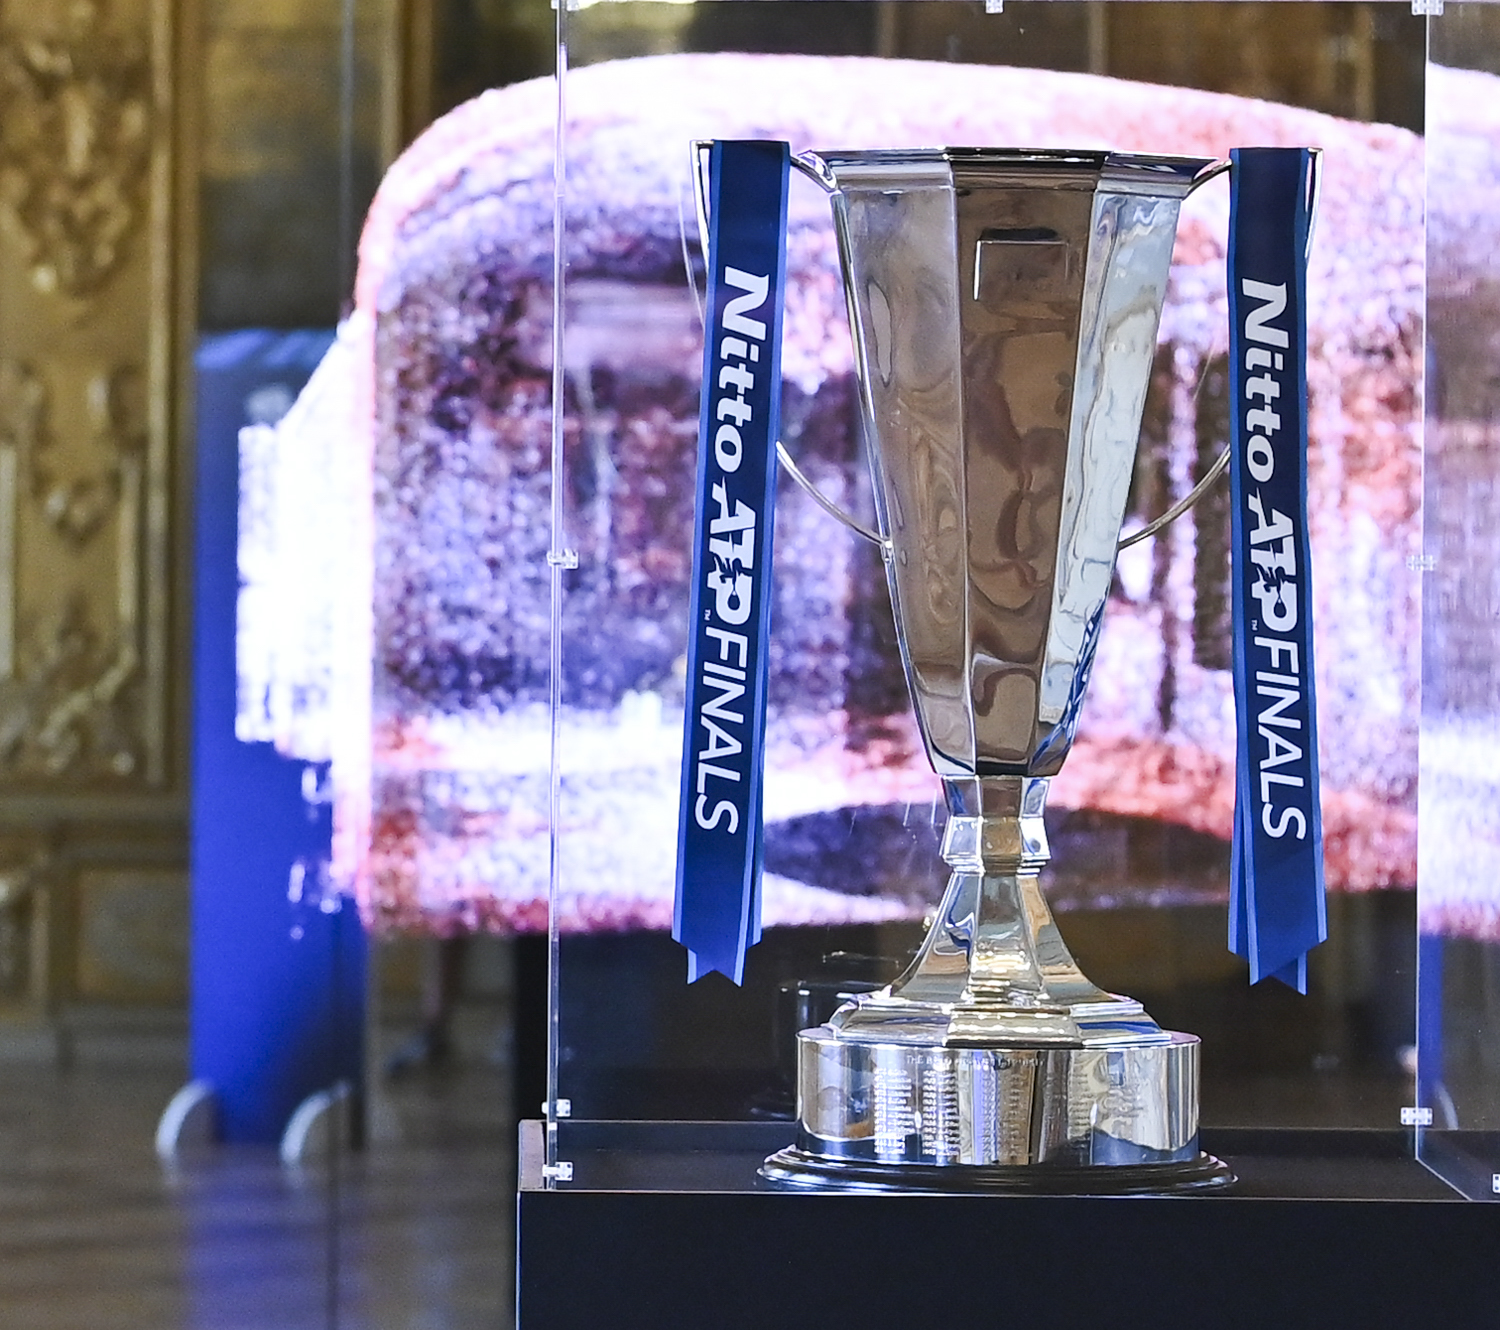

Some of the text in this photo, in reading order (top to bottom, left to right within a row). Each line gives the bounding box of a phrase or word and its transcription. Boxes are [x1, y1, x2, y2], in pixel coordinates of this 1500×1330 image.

[714, 266, 769, 473] Nitto
[1242, 278, 1290, 482] Nitto
[707, 476, 756, 625] ATP
[1248, 487, 1298, 632] ATP
[694, 626, 749, 835] FINALS
[1254, 636, 1307, 840] FINALS
